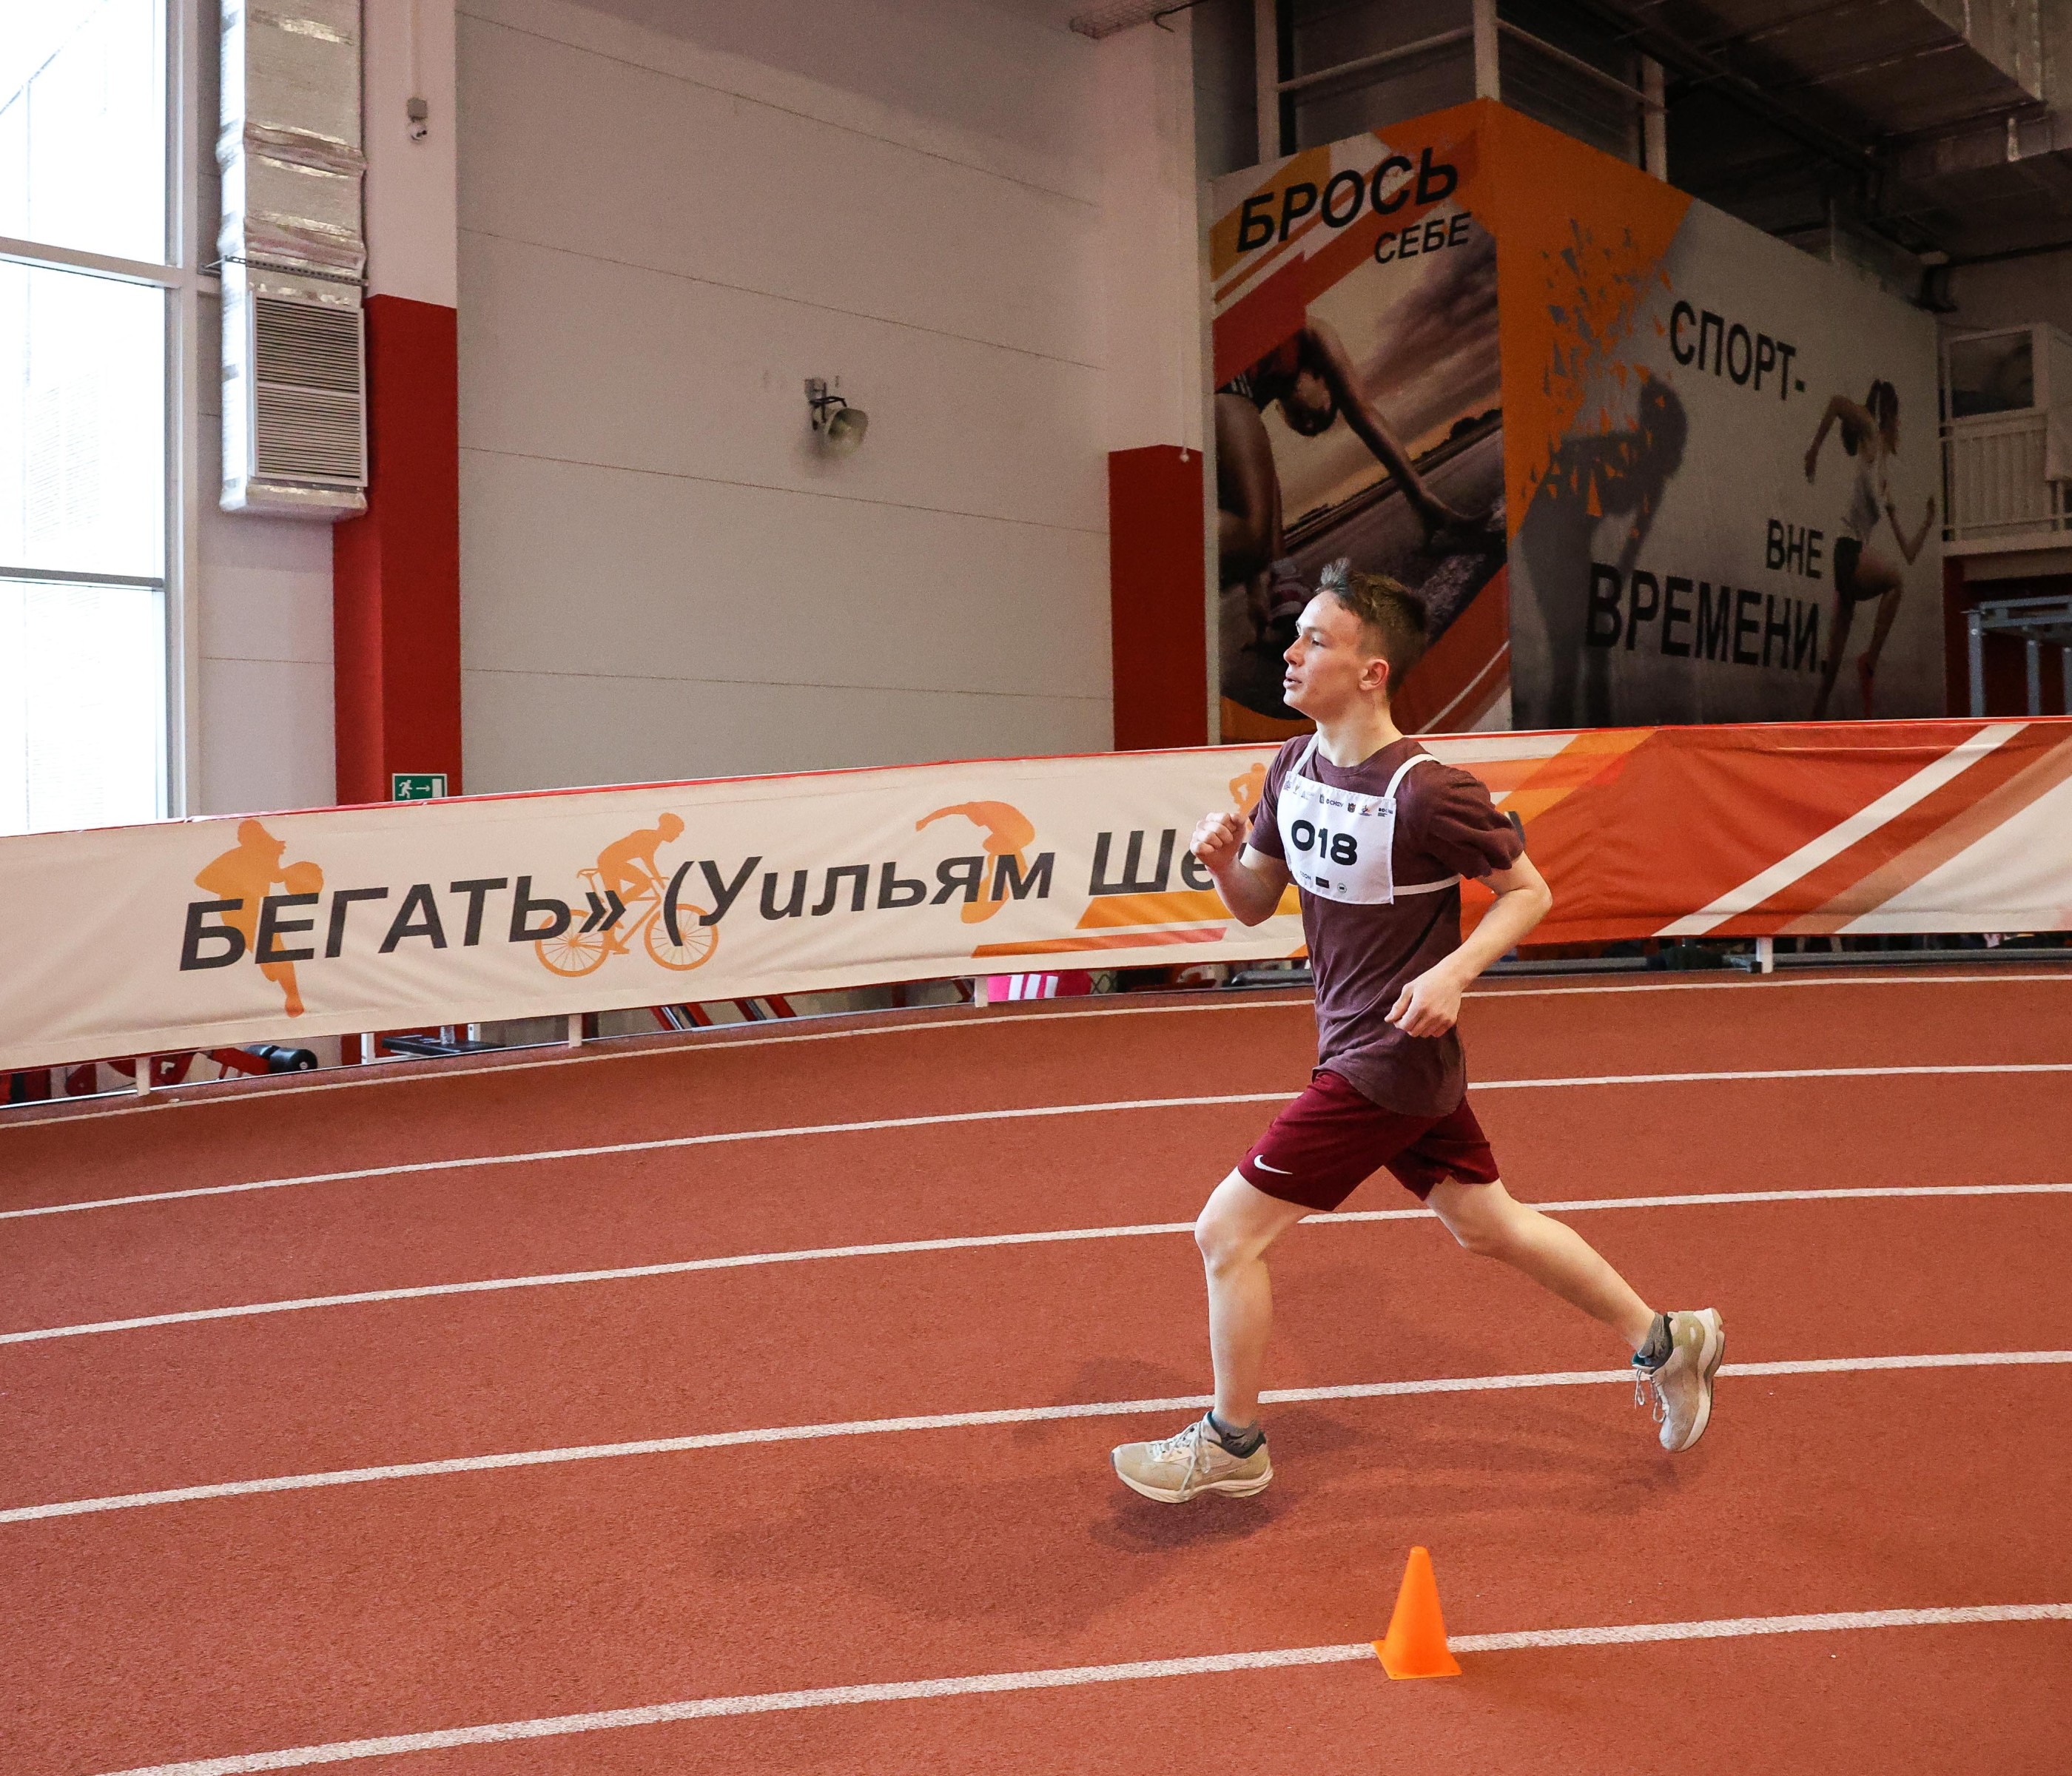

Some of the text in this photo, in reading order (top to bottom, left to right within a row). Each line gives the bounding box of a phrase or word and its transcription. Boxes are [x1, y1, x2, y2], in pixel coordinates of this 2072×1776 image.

[1237, 147, 1459, 253] БРОСЬ
[1374, 212, 1473, 264] СЕБЕ
[1669, 300, 1806, 401] СПОРТ-
[1766, 519, 1824, 579] ВНЕ
[1291, 819, 1358, 866] 018
[179, 875, 627, 972] БЕГАТЬ»
